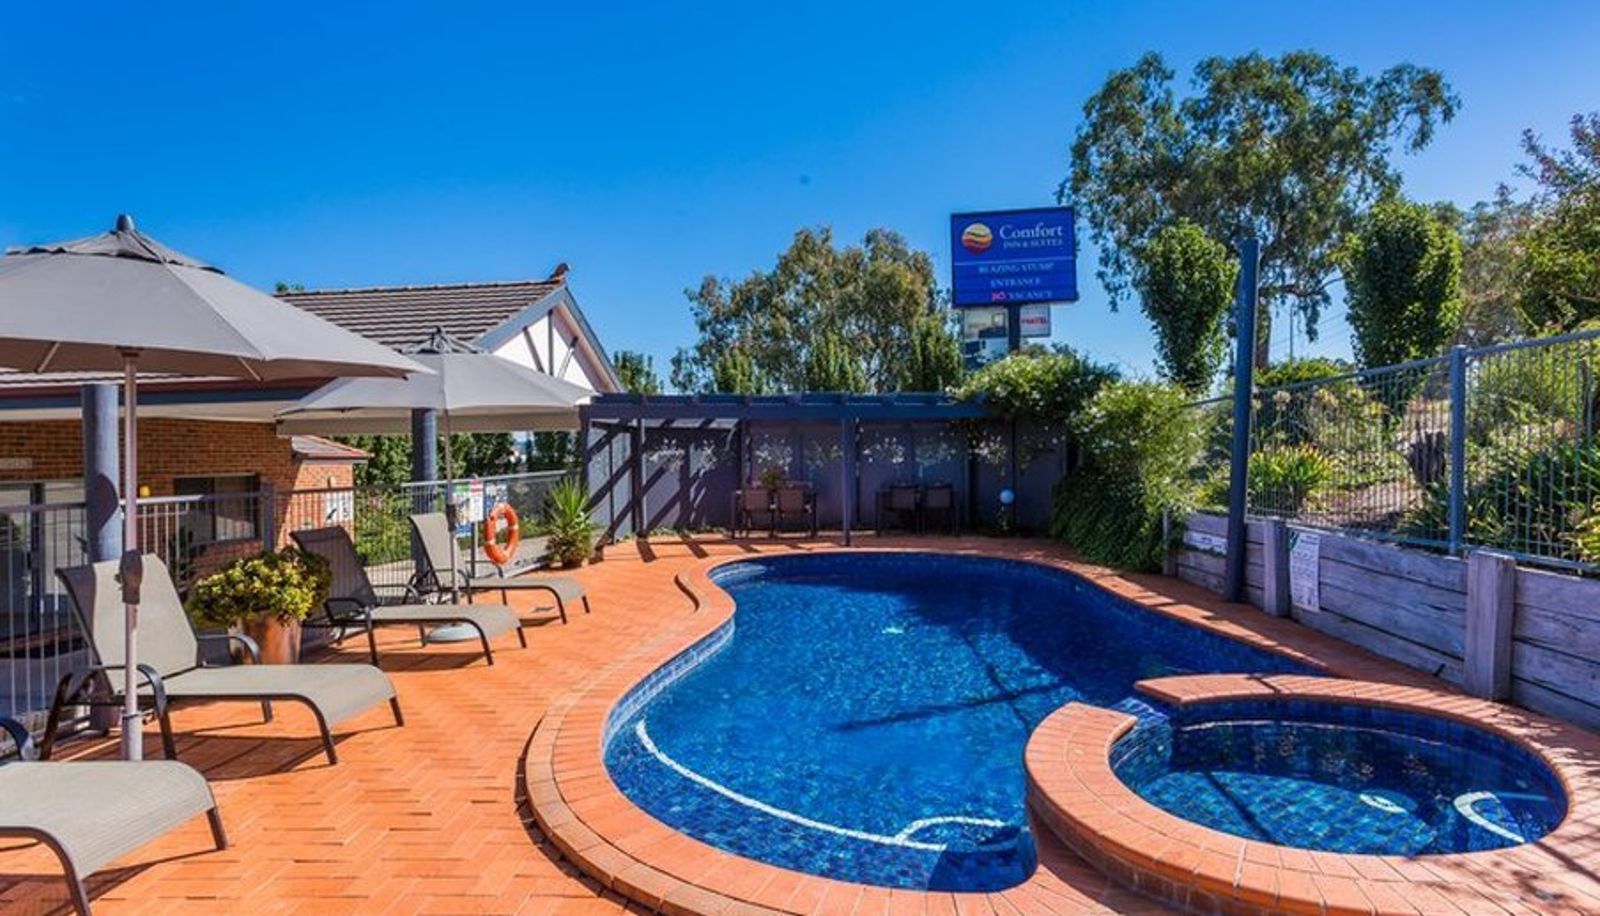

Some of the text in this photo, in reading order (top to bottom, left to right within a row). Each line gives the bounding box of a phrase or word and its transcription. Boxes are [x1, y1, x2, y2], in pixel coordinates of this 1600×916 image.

[1000, 222, 1064, 239] Comfort
[1003, 240, 1020, 249] INN
[991, 277, 1041, 288] ENTRANCE
